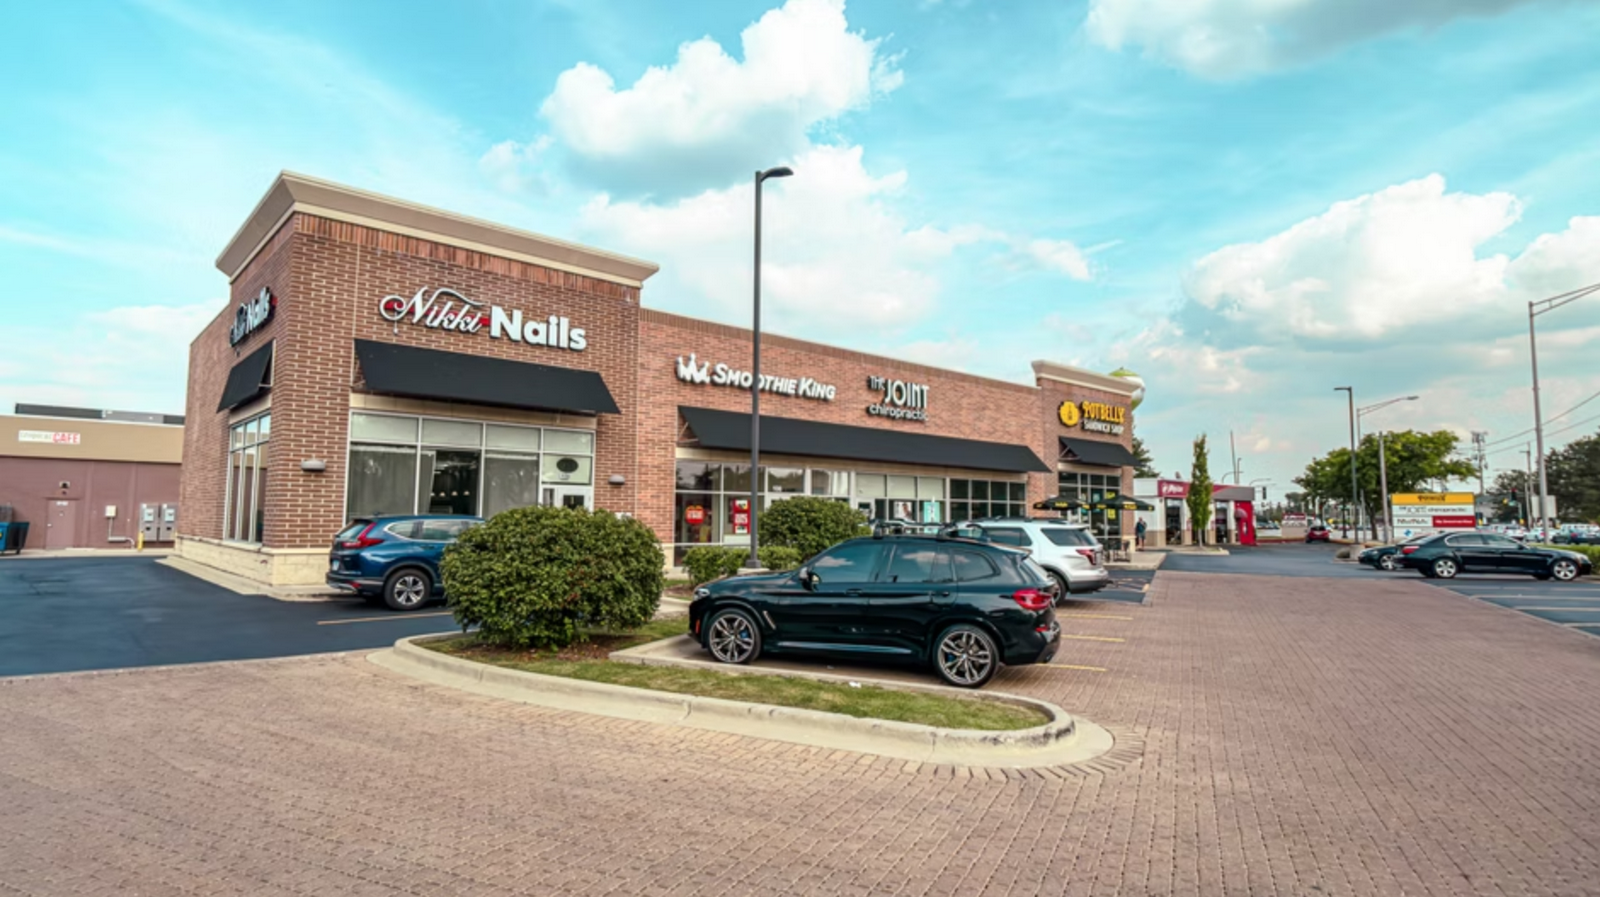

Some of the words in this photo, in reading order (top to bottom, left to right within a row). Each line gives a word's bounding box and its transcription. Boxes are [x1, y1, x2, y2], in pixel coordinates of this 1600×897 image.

[379, 285, 485, 334] Nikki
[489, 305, 588, 351] Nails
[798, 376, 836, 400] KING
[885, 378, 930, 409] JOINT
[869, 403, 929, 421] chiropractic
